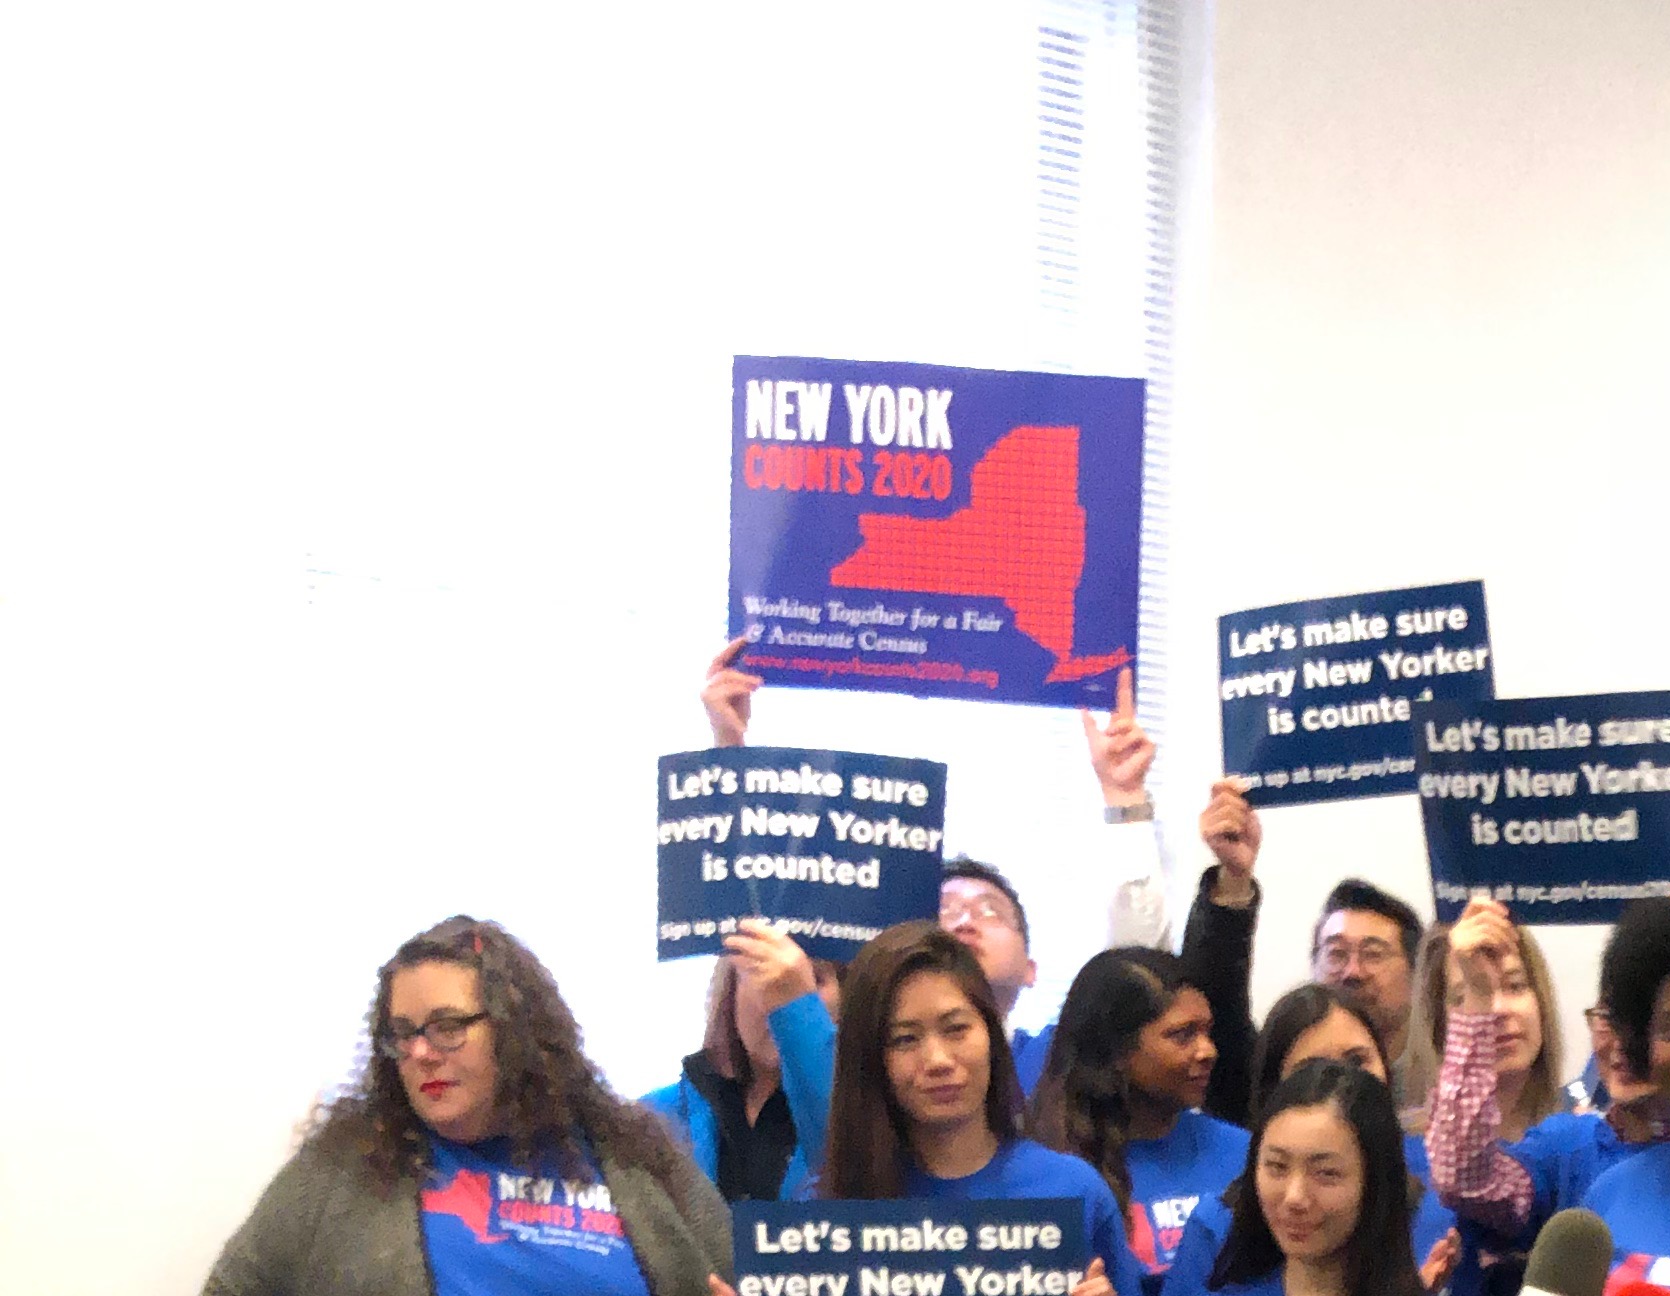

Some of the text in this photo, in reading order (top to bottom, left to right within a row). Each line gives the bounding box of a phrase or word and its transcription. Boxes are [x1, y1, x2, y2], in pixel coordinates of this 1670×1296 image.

[746, 380, 953, 450] NEW YORK
[744, 444, 953, 500] COUNTS 2020
[1229, 606, 1469, 658] Let's make sure
[1221, 644, 1490, 699] every New Yorker
[1267, 690, 1430, 735] is counte
[1425, 718, 1500, 752] Let's
[1503, 717, 1592, 750] make
[669, 763, 929, 807] Let's make sure
[1419, 770, 1500, 804] every
[1504, 766, 1578, 797] New
[658, 806, 942, 851] every New Yorker
[1470, 807, 1639, 845] is counted
[703, 854, 880, 889] is counted
[754, 1218, 1061, 1253] Let's make sure
[954, 1264, 1083, 1296] Yorker
